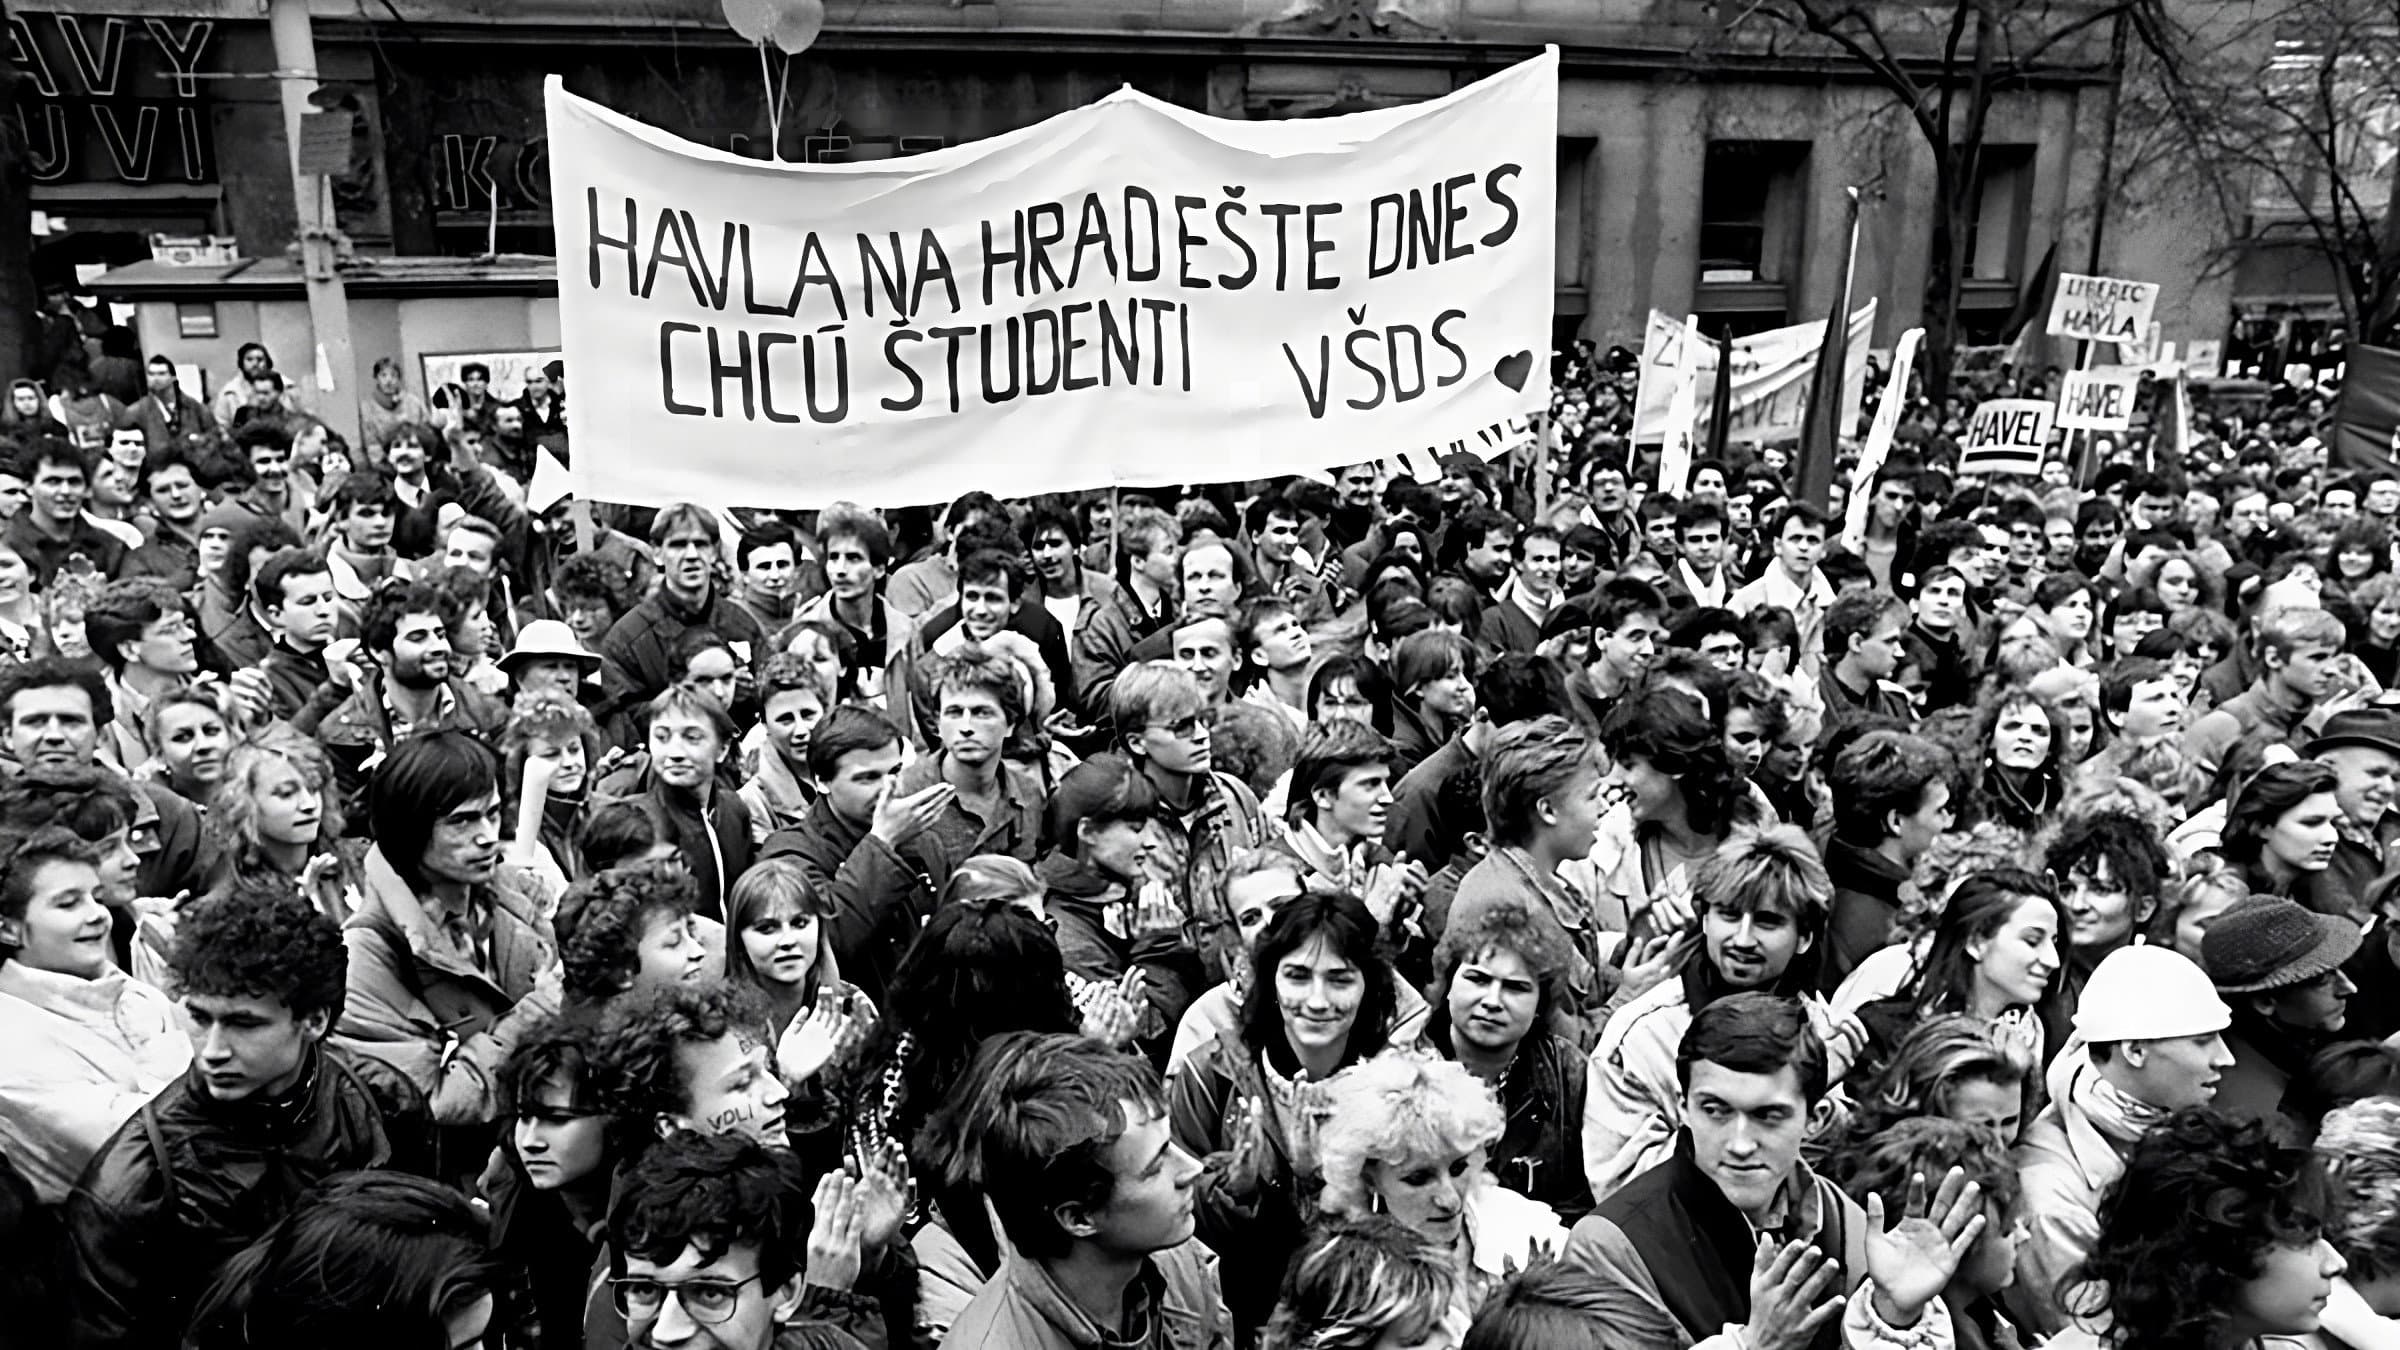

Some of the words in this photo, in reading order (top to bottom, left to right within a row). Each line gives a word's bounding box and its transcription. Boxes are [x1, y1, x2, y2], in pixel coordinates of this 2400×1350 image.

[588, 187, 848, 321] HAVLA
[857, 229, 961, 318] NA
[1369, 164, 1522, 280] DNES
[661, 322, 849, 424] CHCÚ
[881, 302, 1191, 414] ŠTUDENTI
[1283, 304, 1468, 419] VŠDS
[2067, 383, 2124, 419] HAVEL
[1970, 410, 2042, 448] HAVEL
